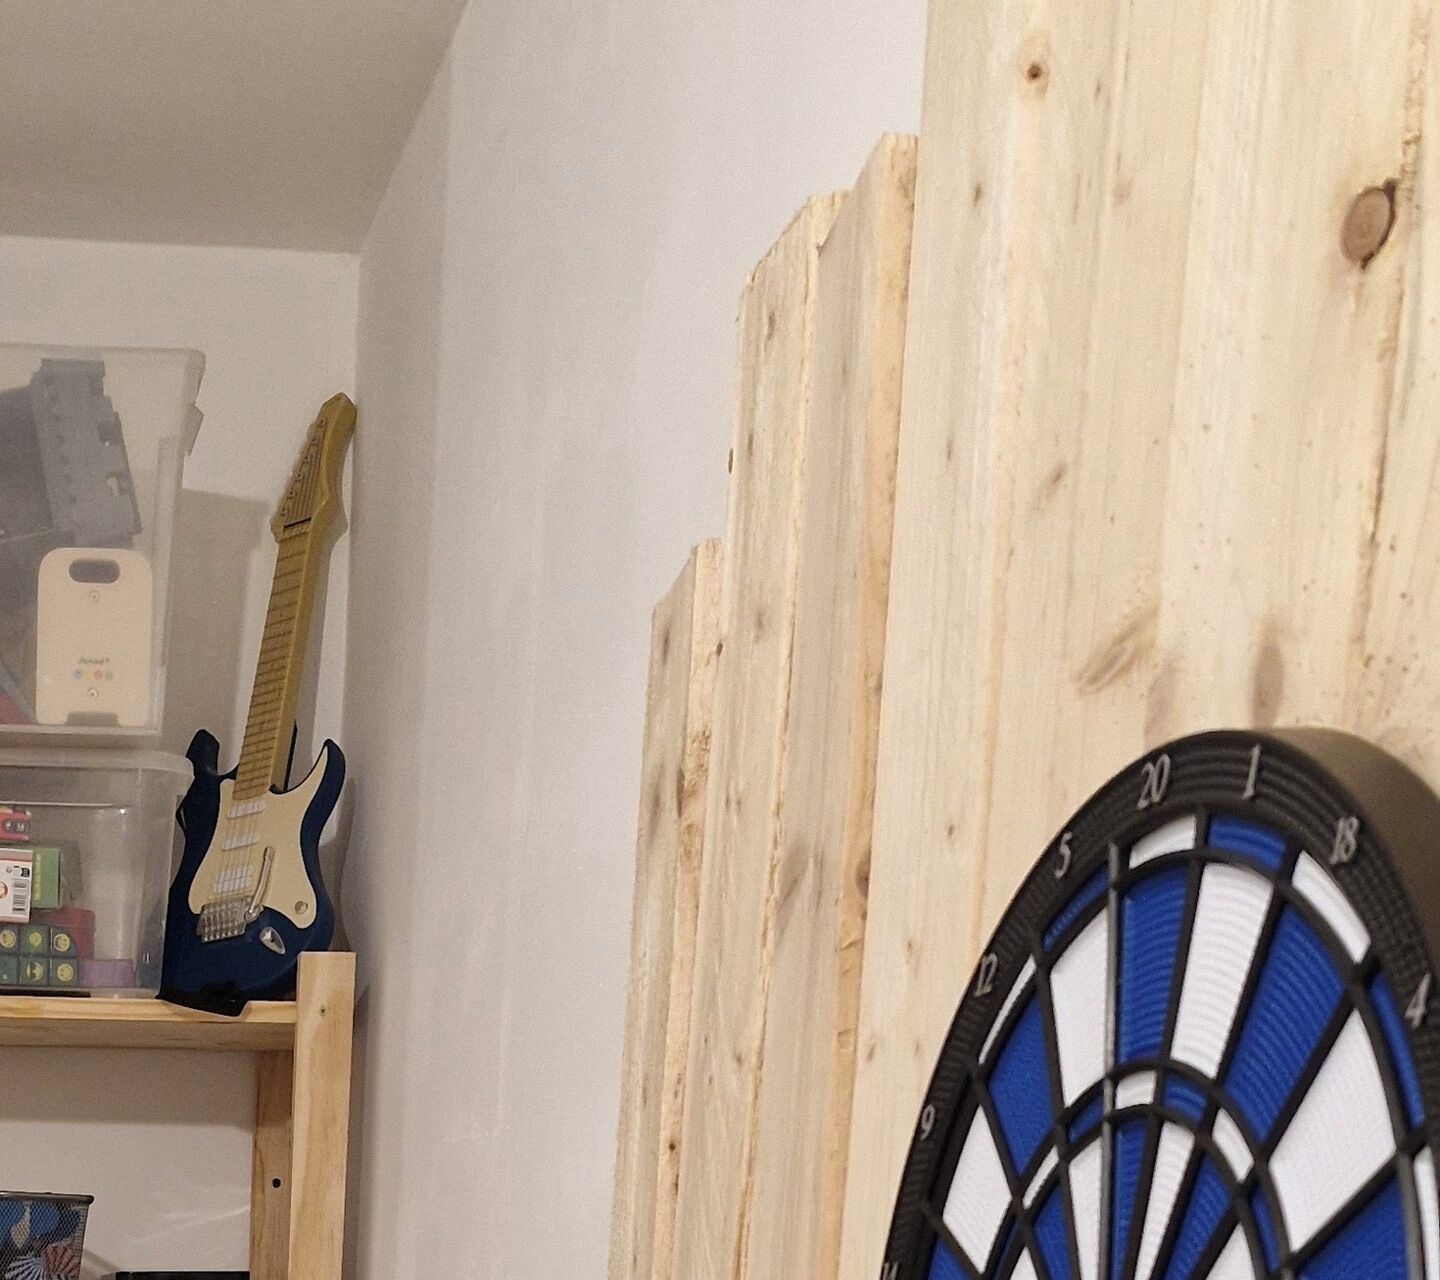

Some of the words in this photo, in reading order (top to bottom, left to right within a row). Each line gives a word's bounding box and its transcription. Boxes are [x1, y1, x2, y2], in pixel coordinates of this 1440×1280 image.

[1137, 753, 1172, 810] 20
[1242, 743, 1262, 800] 1
[1054, 832, 1074, 879] 5
[1330, 816, 1361, 866] 18
[974, 952, 998, 998] 12
[1406, 973, 1431, 1029] 4
[921, 1103, 936, 1140] 9
